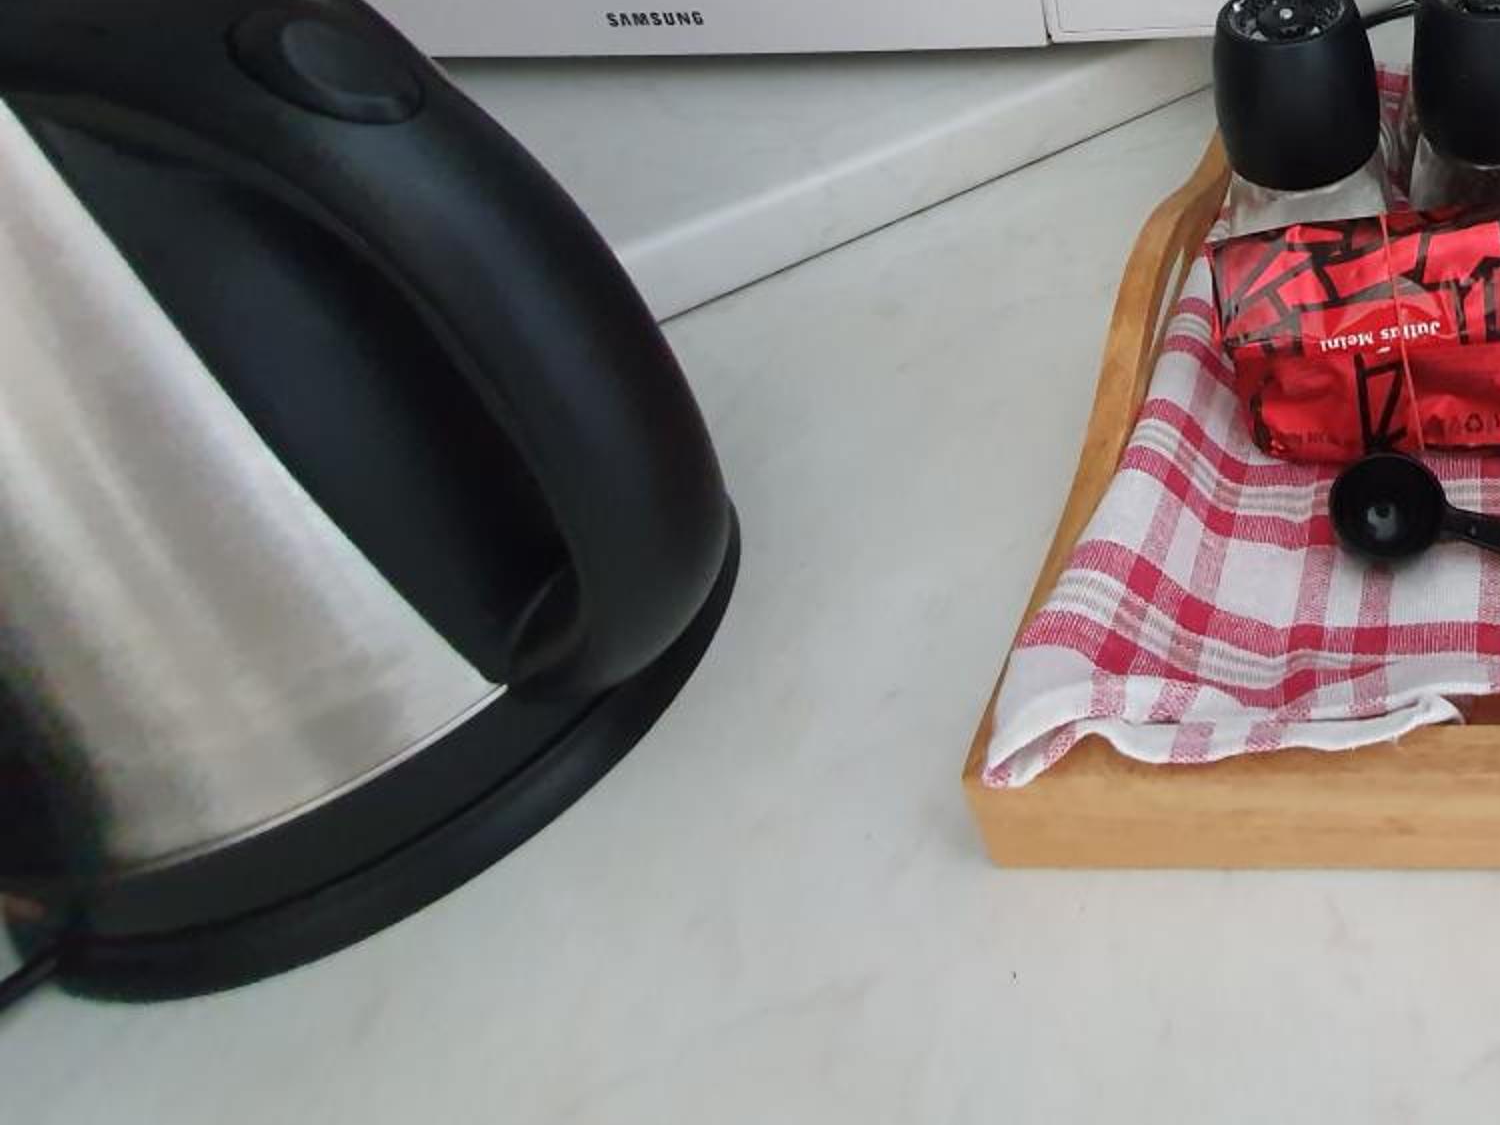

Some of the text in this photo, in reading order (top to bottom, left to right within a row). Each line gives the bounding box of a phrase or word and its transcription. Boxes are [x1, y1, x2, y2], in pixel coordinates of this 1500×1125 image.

[606, 11, 704, 27] SAMSUNG
[1320, 321, 1441, 352] Julius Meinl
